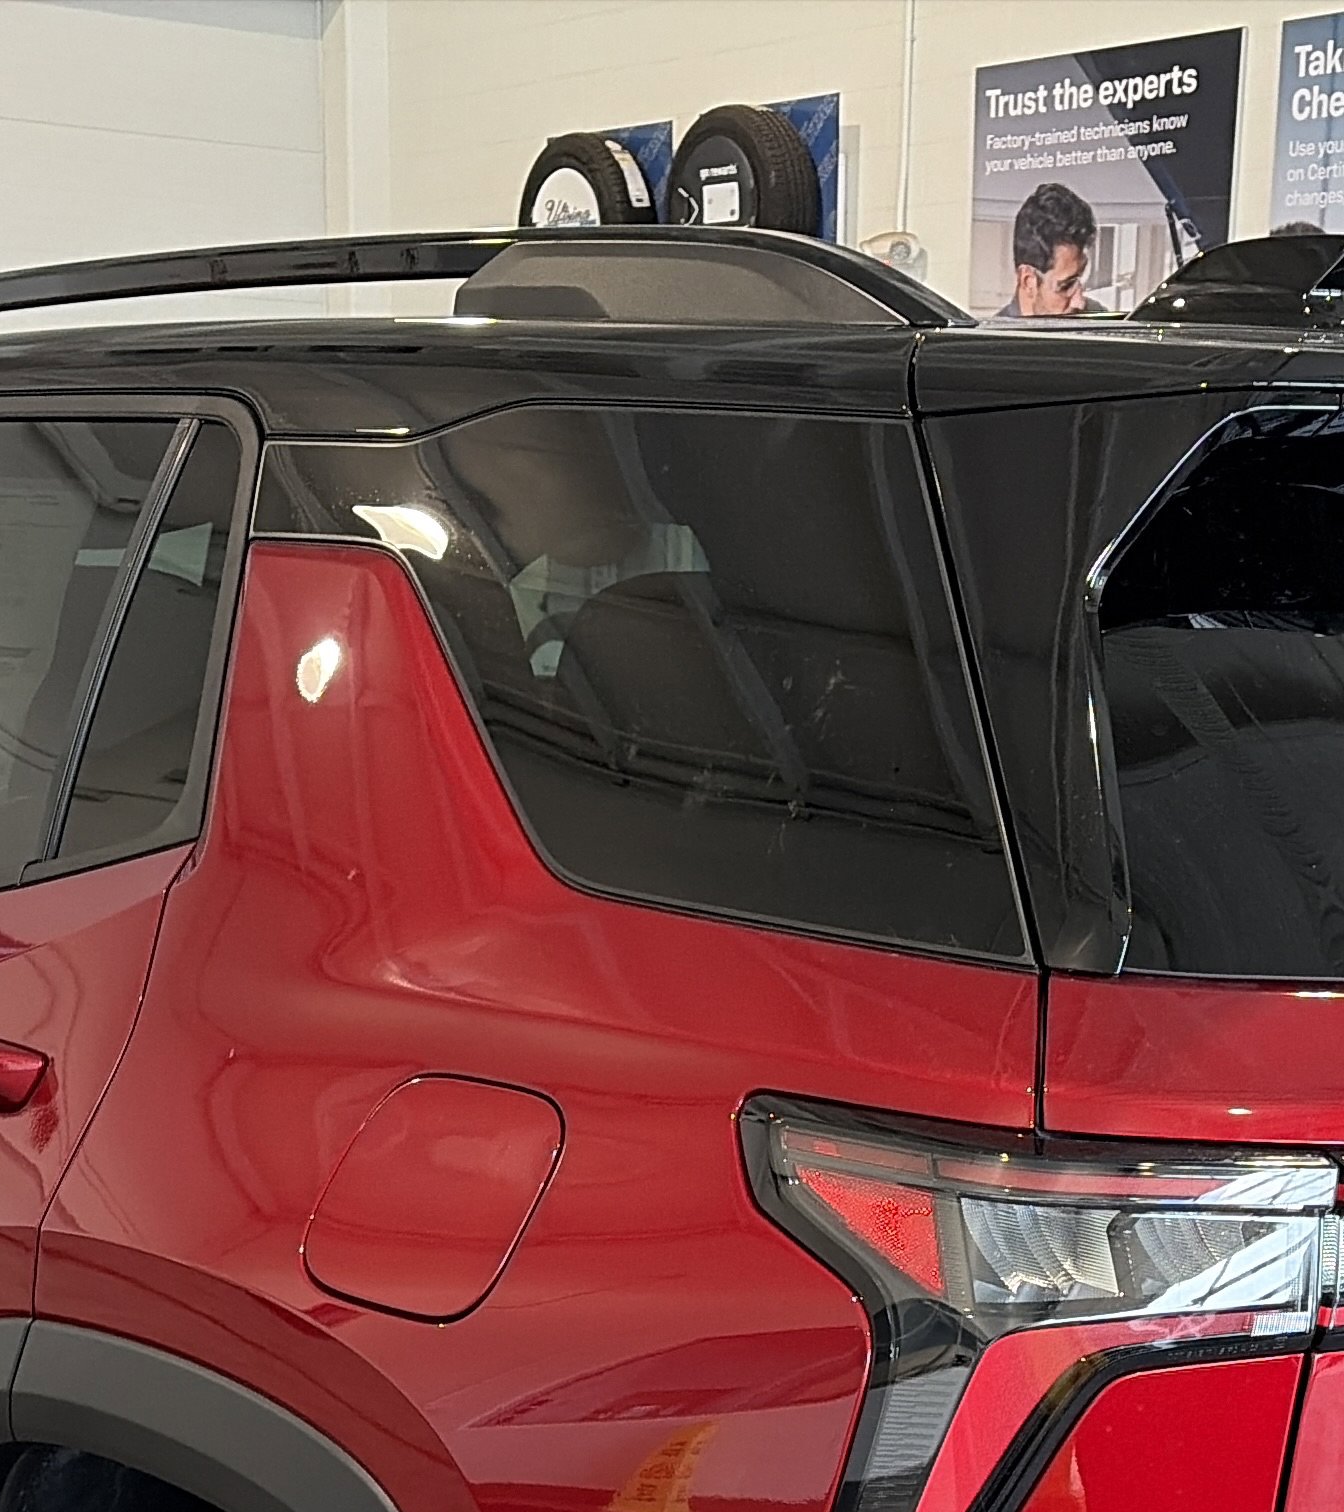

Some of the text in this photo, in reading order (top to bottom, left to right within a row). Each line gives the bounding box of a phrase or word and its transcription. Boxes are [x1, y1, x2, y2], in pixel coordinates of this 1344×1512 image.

[985, 64, 1199, 119] Trust the experts
[986, 113, 1189, 151] Factory-trained technicians know
[1288, 139, 1315, 158] Use
[985, 138, 1177, 175] your vehicle better than anyone.
[1286, 167, 1305, 182] on
